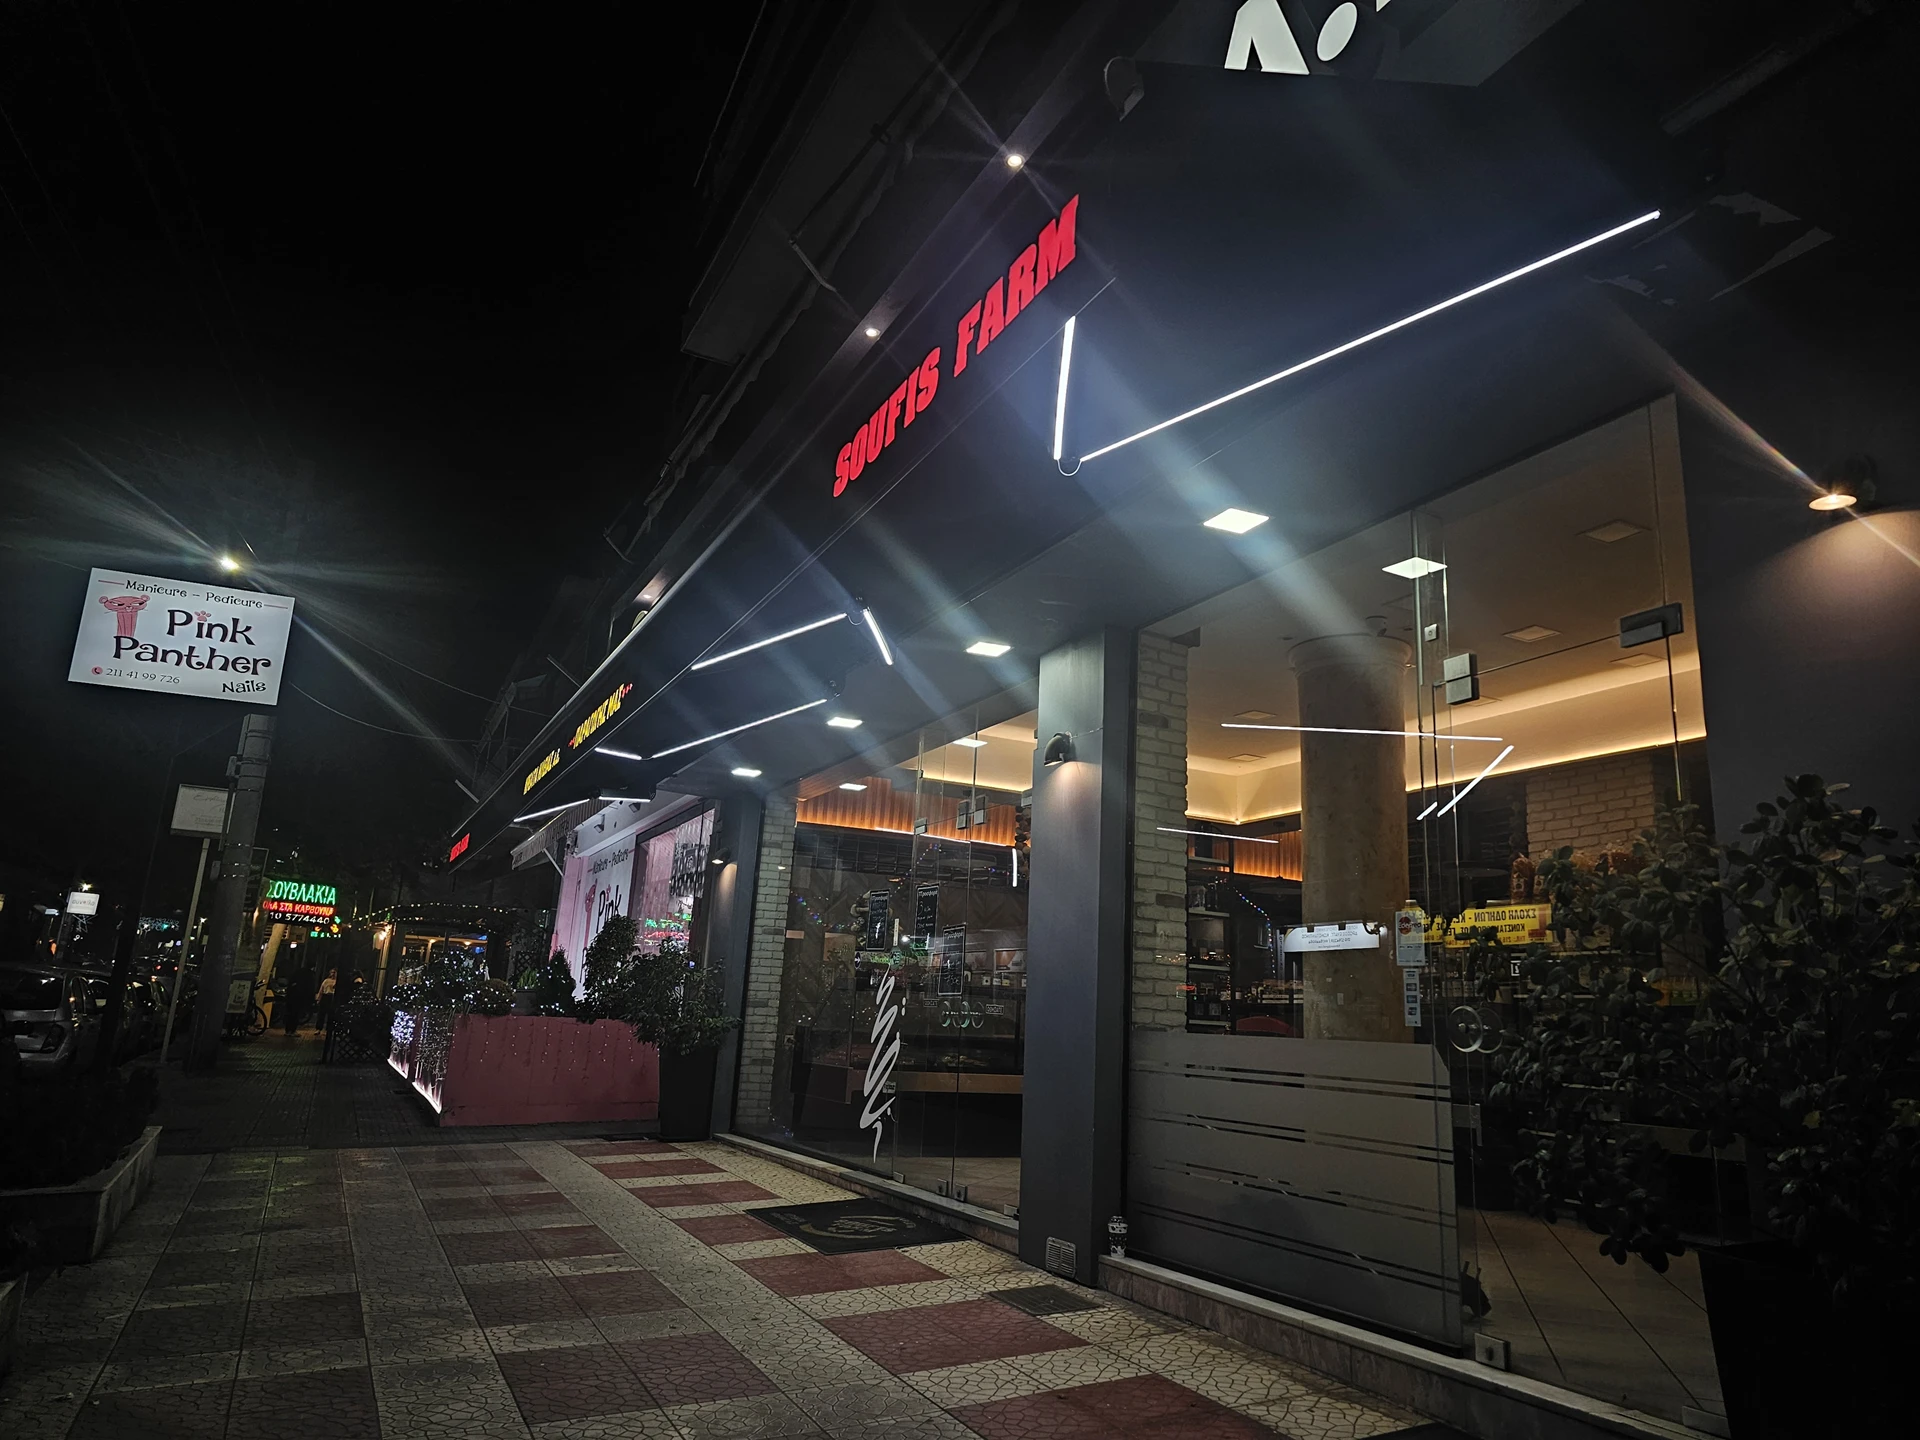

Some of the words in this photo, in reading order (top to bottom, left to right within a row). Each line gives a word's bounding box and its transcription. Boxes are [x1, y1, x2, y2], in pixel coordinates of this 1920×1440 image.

[833, 346, 941, 498] SOUFIS
[953, 193, 1080, 378] FARM
[125, 579, 188, 598] Manicure
[206, 592, 263, 609] Pedicure
[166, 609, 256, 646] Pink
[113, 635, 272, 676] Panther
[106, 667, 123, 677] 211
[126, 670, 138, 679] 41
[142, 671, 157, 681] 99
[160, 674, 180, 684] 726
[222, 679, 267, 694] Nails
[266, 880, 336, 905] ΣΟΥΒΛΑΚΙΑ
[279, 902, 293, 912] ΣΤΑ
[596, 884, 622, 934] Pink
